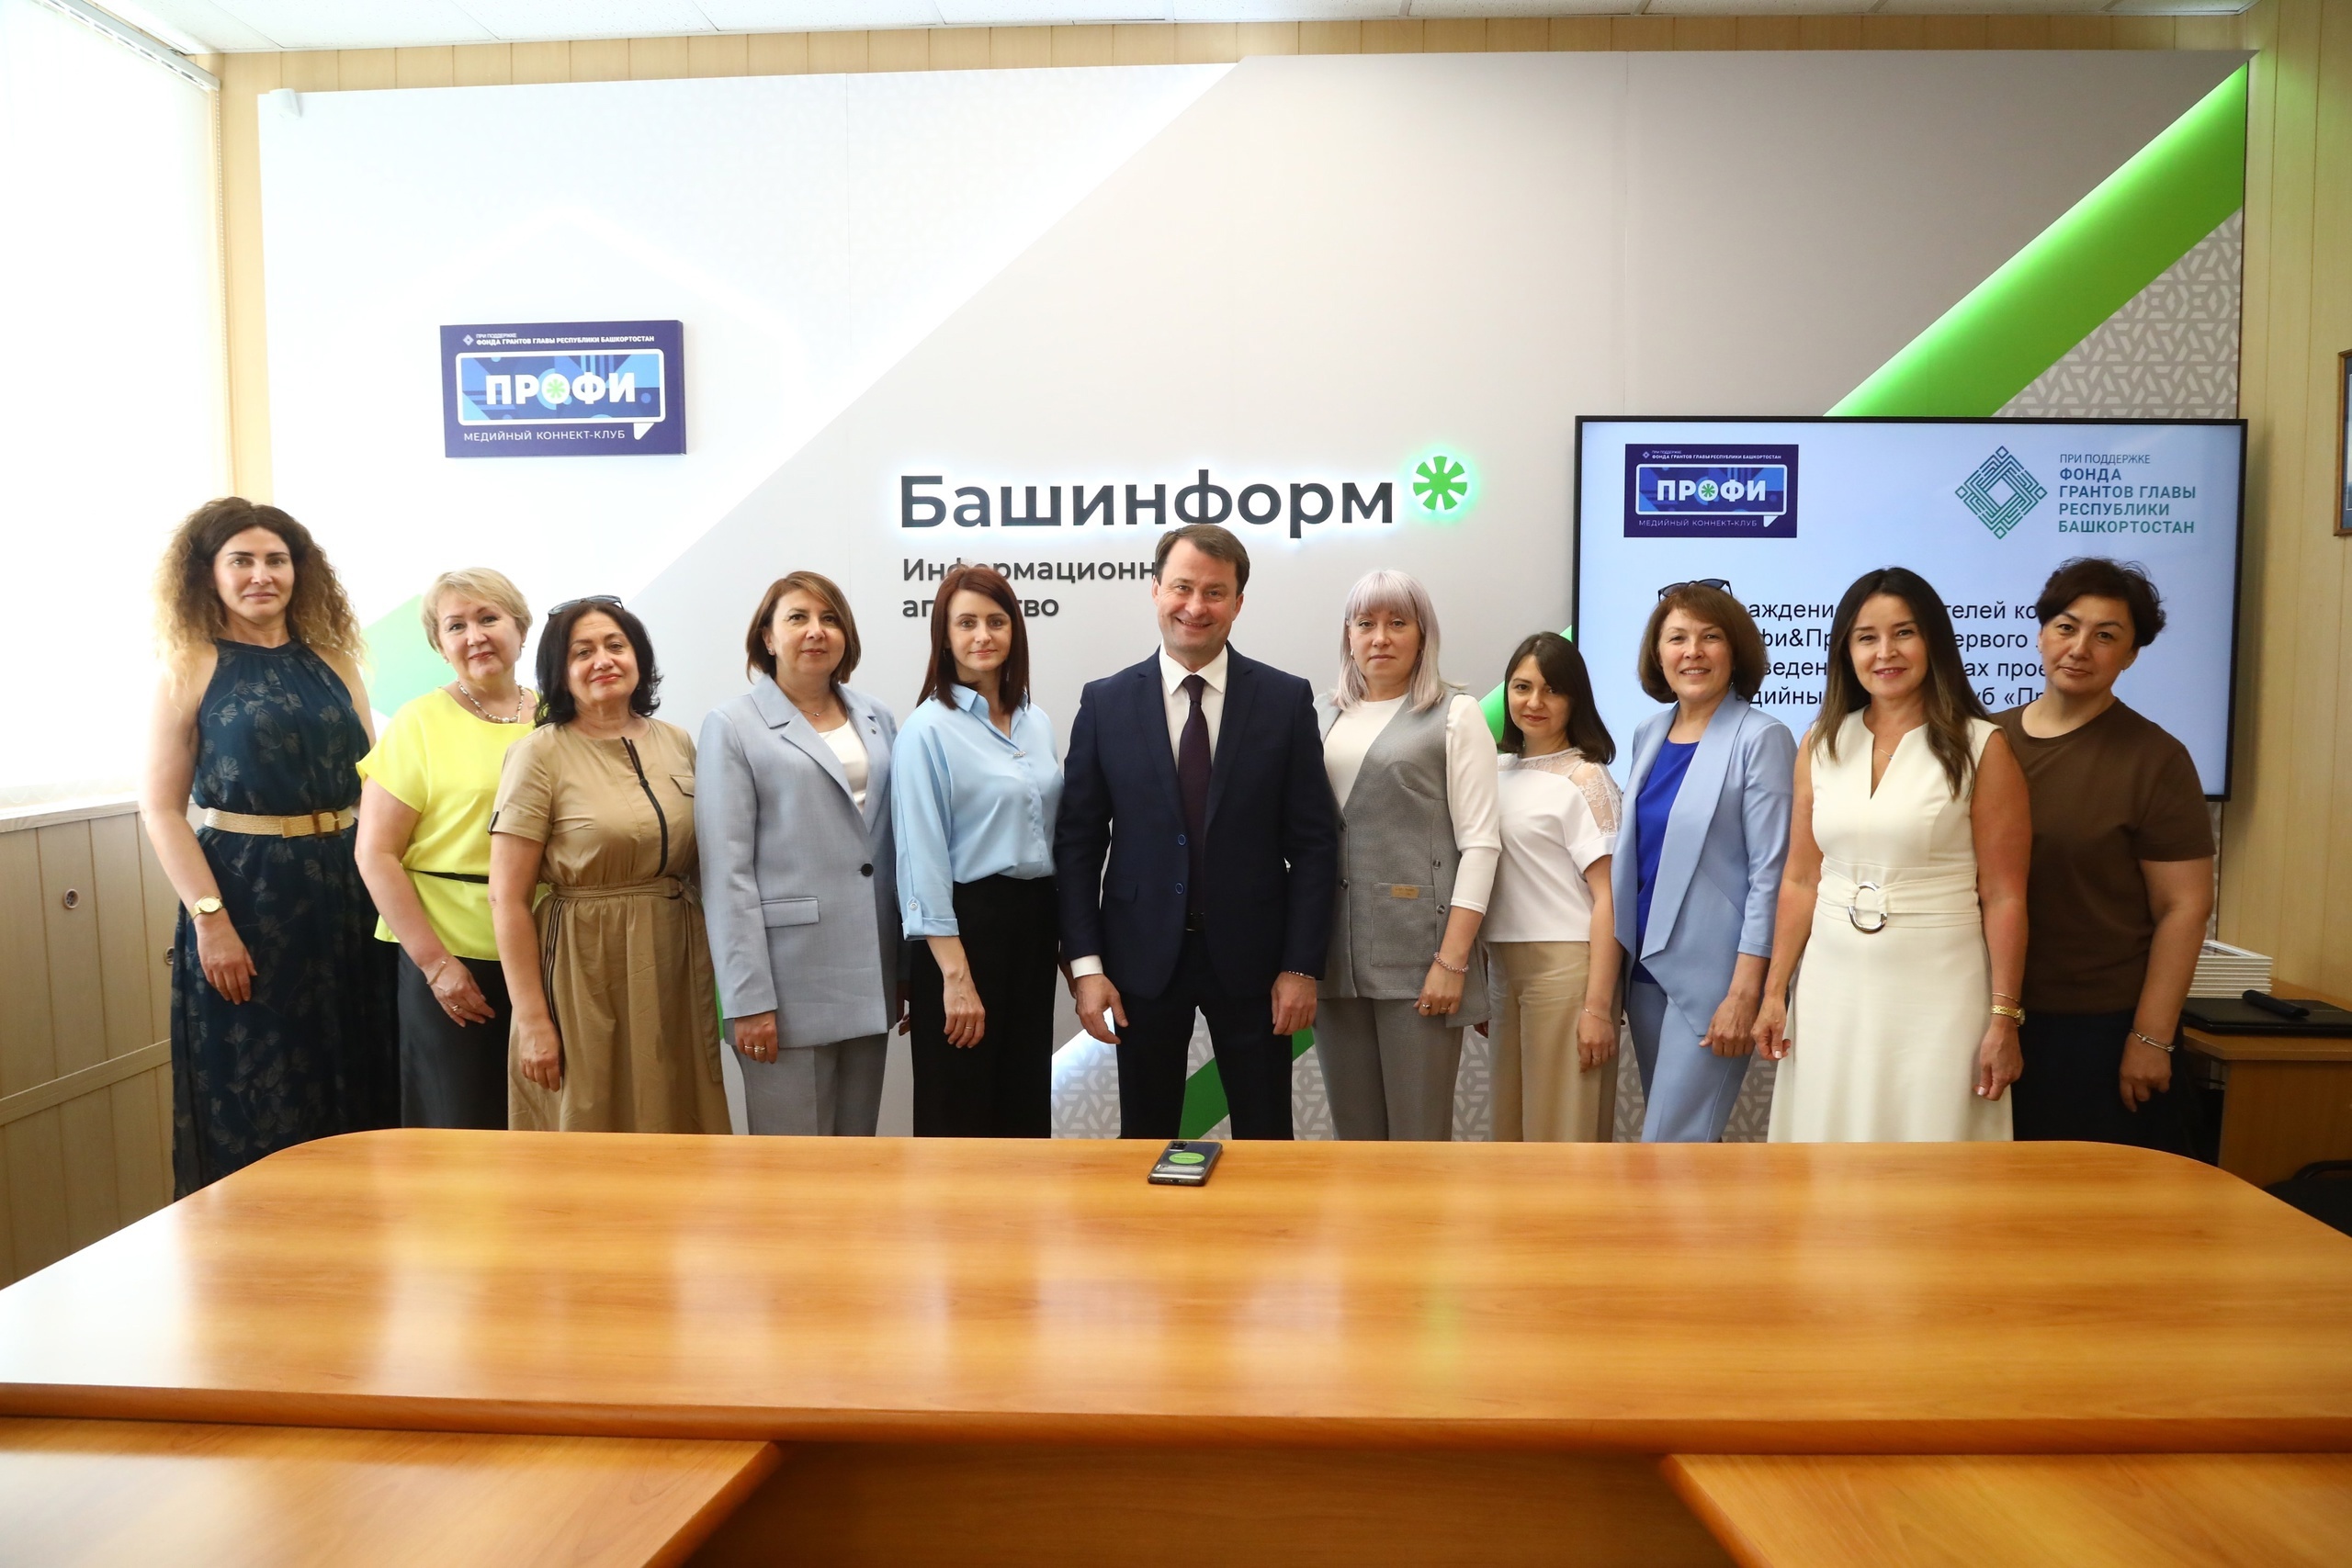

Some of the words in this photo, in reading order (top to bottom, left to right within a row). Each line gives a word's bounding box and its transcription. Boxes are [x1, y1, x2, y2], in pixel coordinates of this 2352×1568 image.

[486, 372, 635, 405] ПРОФИ
[464, 430, 532, 442] МЕДИЙНЫЙ
[537, 430, 625, 440] КОННЕКТ-КЛУБ
[2060, 454, 2081, 463] ПРИ
[2085, 454, 2150, 465] ПОДДЕРЖКЕ
[2060, 468, 2122, 483] ФОНДА
[1657, 479, 1766, 502] ПРОФИ
[2059, 486, 2133, 498] ГРАНТОВ
[2140, 486, 2195, 498] ГЛАВЫ
[900, 469, 1393, 539] Башинформ
[2059, 503, 2169, 516] РЕСПУБЛИКИ
[1639, 519, 1689, 527] МЕДИЙНЫЙ
[2058, 520, 2194, 533] БАШКОРТОСТАН
[1749, 604, 1833, 621] аждени
[1954, 634, 2028, 652] ервого
[1749, 686, 1822, 708] дийны
